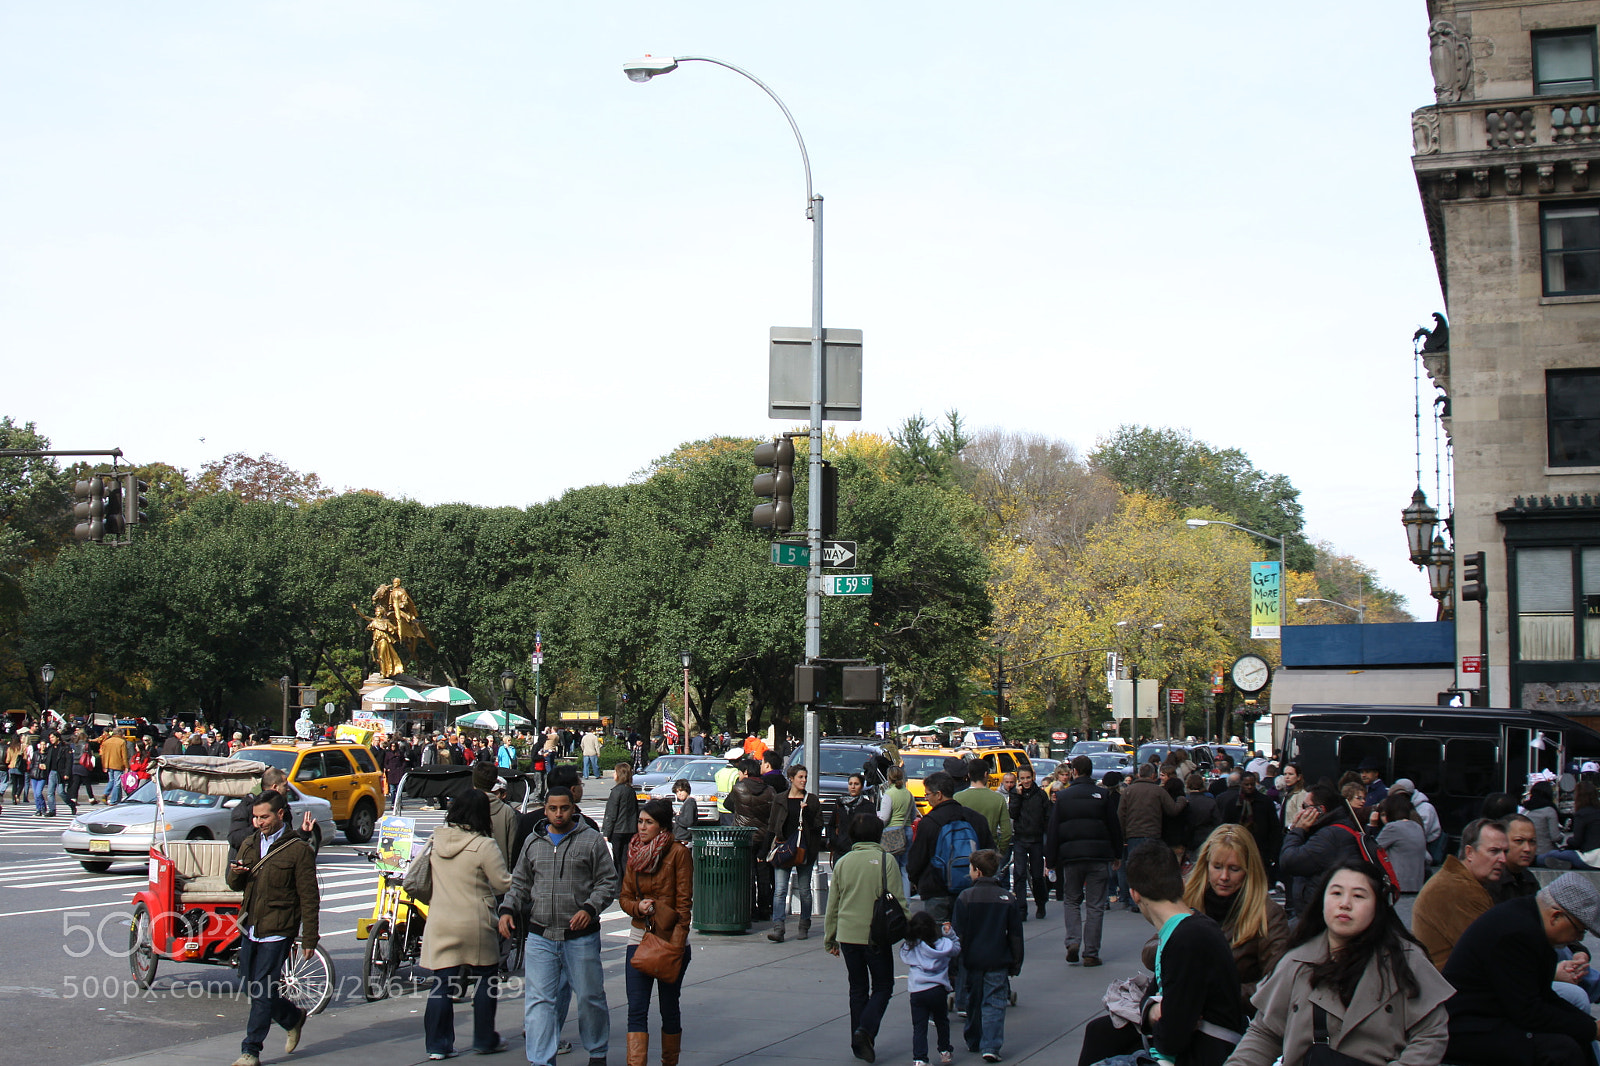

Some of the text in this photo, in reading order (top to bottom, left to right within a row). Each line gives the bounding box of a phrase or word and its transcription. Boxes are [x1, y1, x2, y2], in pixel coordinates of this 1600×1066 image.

[788, 547, 796, 562] 5
[823, 549, 846, 560] WAY
[836, 577, 871, 593] E 59 ST
[1253, 572, 1278, 586] GET
[1255, 601, 1278, 616] NYC
[1536, 690, 1548, 702] A
[1555, 689, 1576, 702] LA
